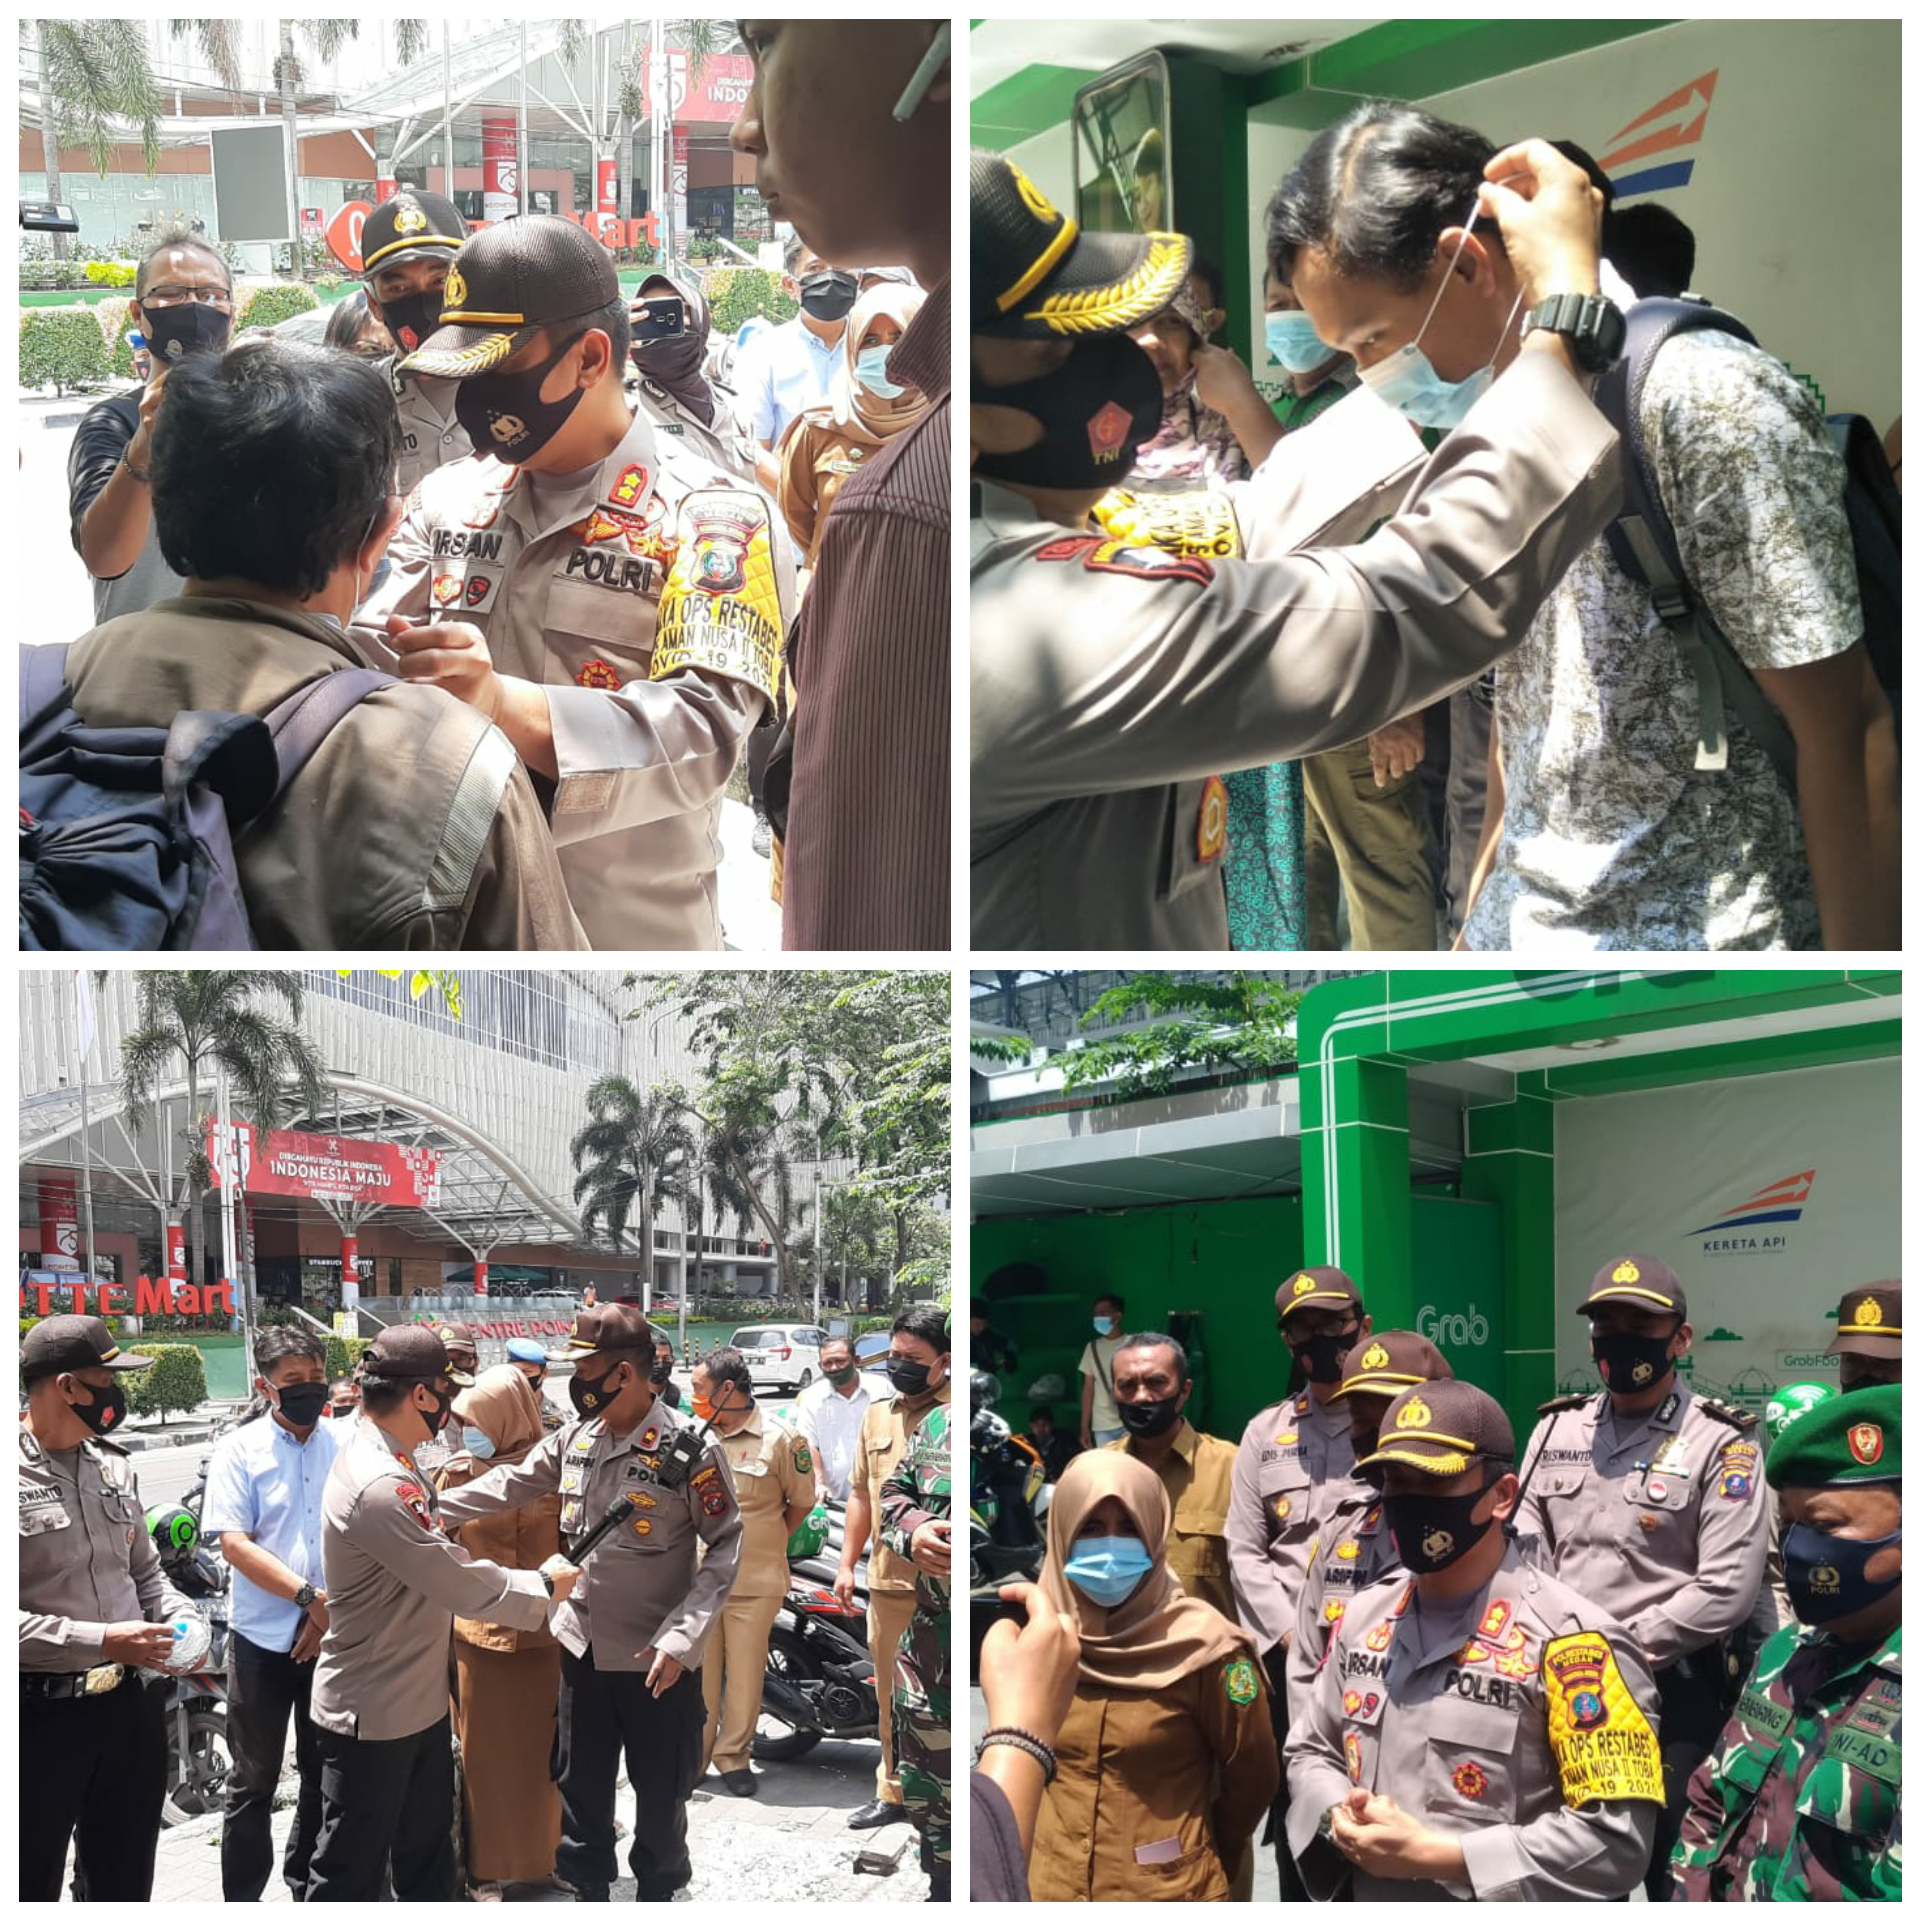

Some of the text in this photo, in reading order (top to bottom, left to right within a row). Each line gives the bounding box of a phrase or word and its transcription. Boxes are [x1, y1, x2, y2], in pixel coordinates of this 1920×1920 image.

[1092, 448, 1120, 466] TNI
[433, 529, 503, 560] IRSAN
[567, 550, 653, 592] POLRI
[700, 626, 737, 653] NUSA
[270, 1160, 351, 1183] INDONESIA
[356, 1171, 391, 1186] MAJU
[1703, 1236, 1786, 1252] KERETA API
[134, 1276, 235, 1315] Mart
[1416, 1303, 1489, 1346] Grab
[1347, 1651, 1392, 1681] IRSAN
[1443, 1668, 1513, 1707] POLRI
[1569, 1734, 1594, 1763] OPS
[1597, 1729, 1653, 1759] RESTABES
[1590, 1758, 1621, 1780] NUSA
